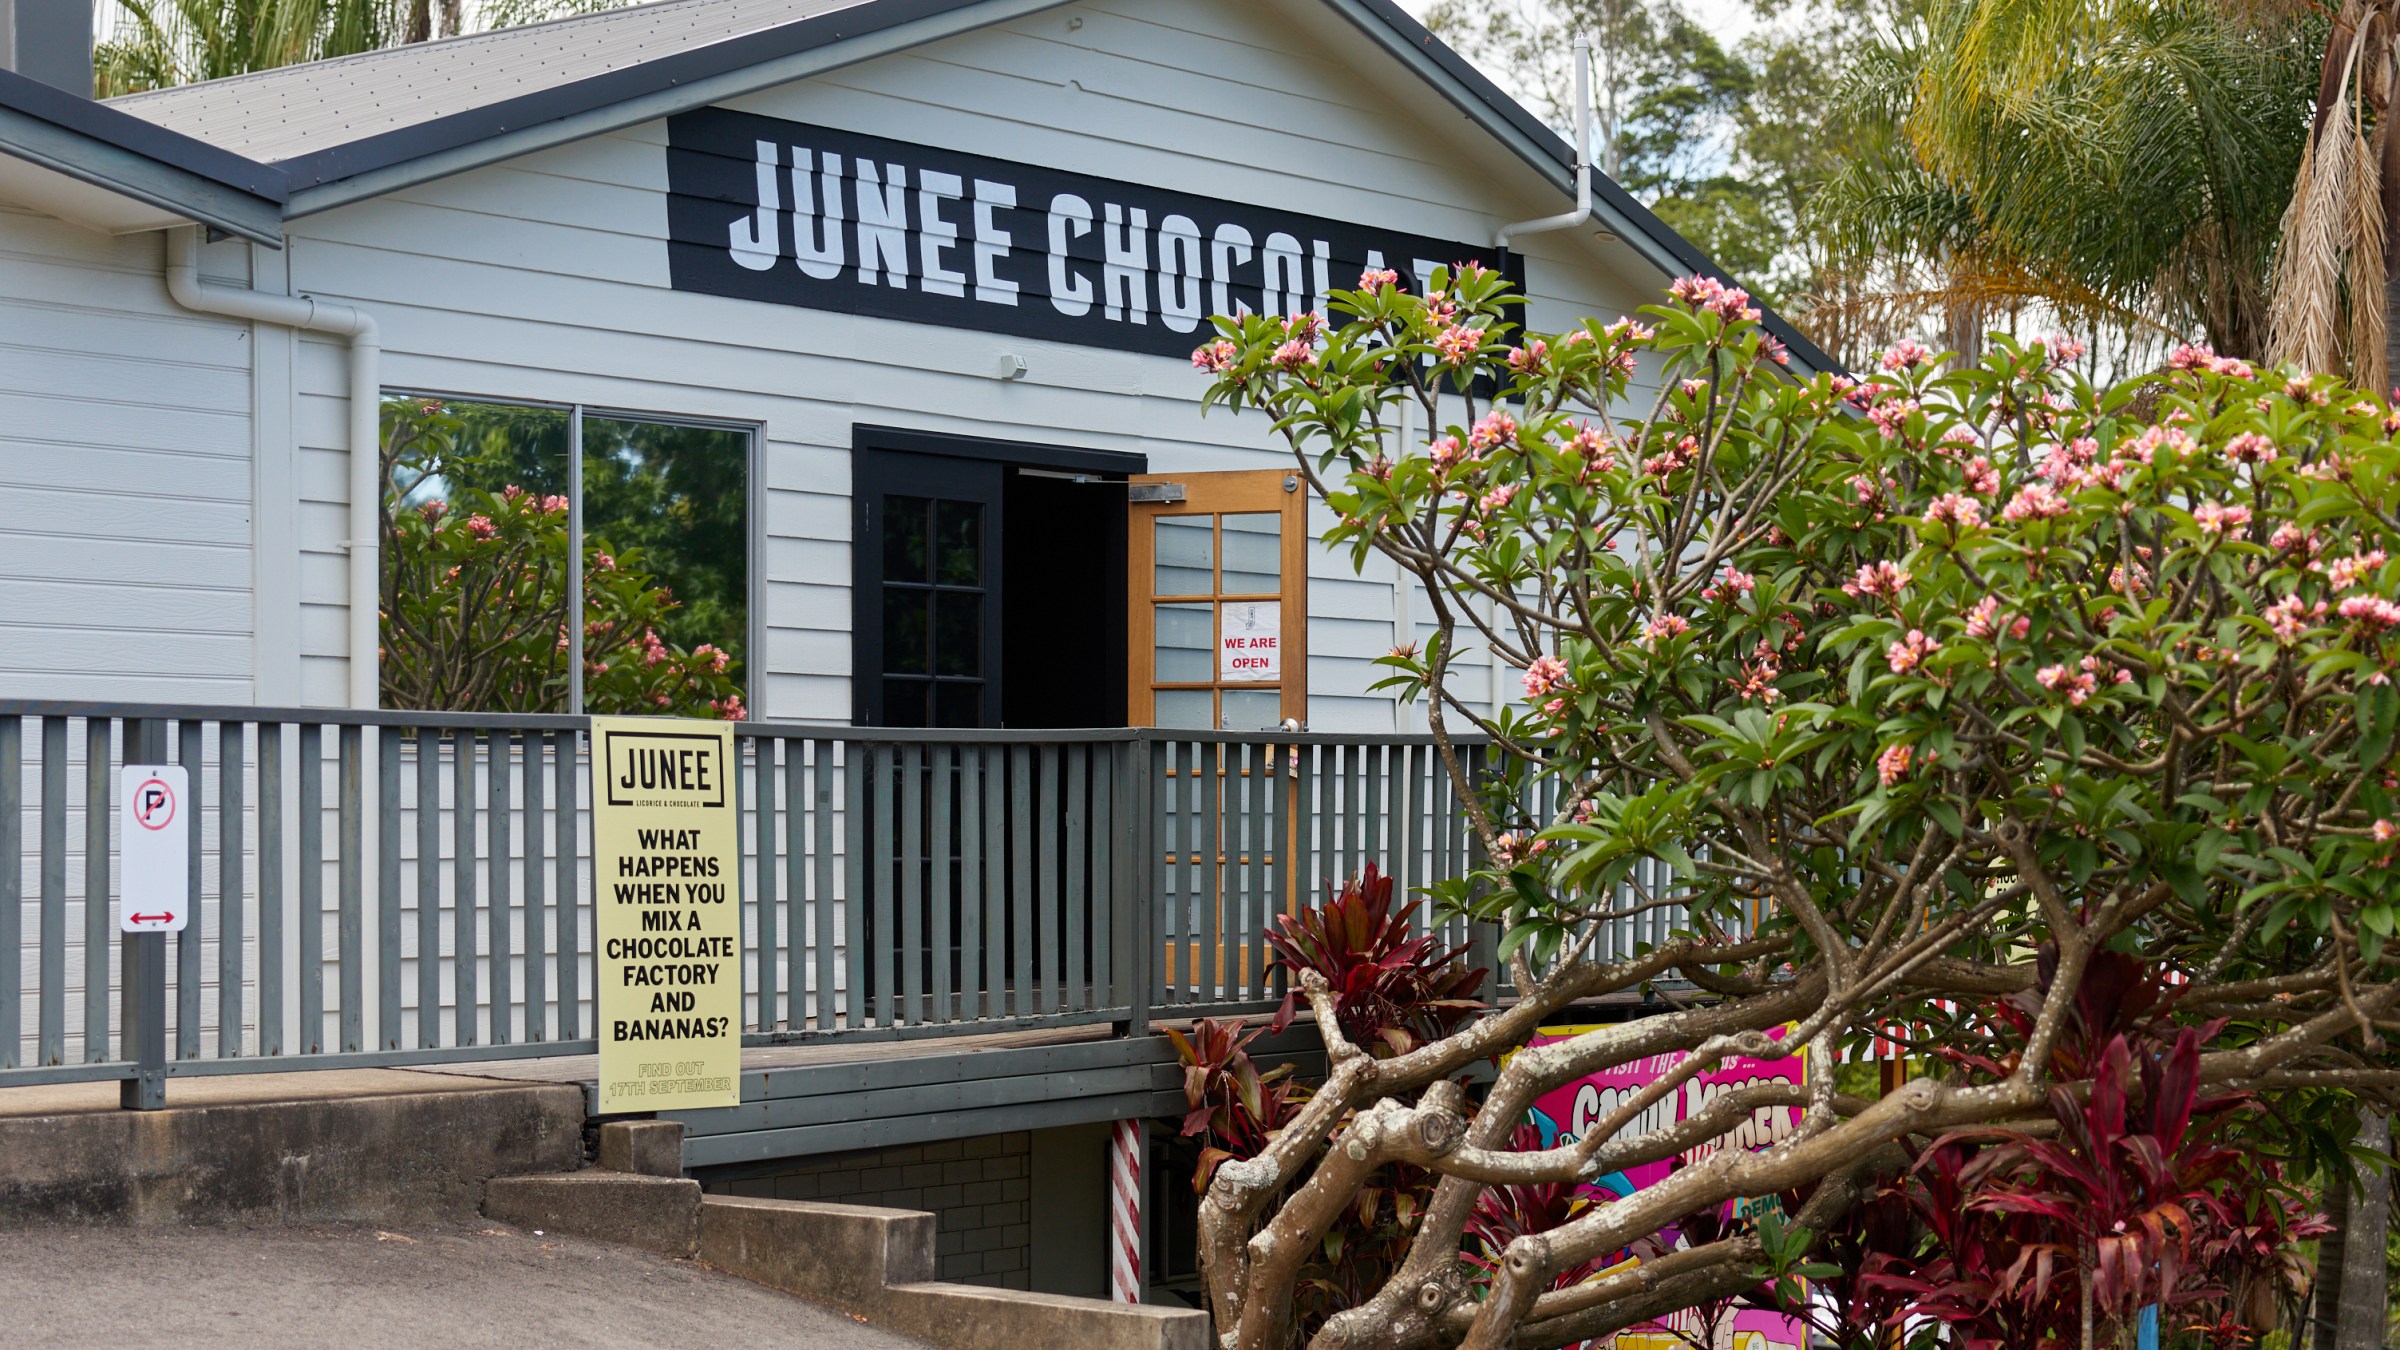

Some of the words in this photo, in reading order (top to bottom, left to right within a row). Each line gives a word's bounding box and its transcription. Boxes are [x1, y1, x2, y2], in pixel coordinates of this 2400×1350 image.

[729, 139, 1019, 308] JUNEE
[1047, 193, 1489, 377] CHOCOLAT
[1225, 638, 1245, 648] WE
[1249, 637, 1277, 648] ARE
[1232, 657, 1269, 668] OPEN
[620, 748, 712, 791] JUNEE
[636, 799, 662, 807] LICORICE
[669, 800, 700, 808] CHOCOLATE
[638, 829, 701, 850] WHAT
[619, 856, 720, 877] HAPPENS
[614, 883, 680, 904] WHEN
[684, 883, 725, 904] YOU
[642, 910, 682, 932] MIX
[687, 910, 702, 931] A
[606, 937, 734, 960] CHOCOLATE
[623, 963, 719, 986] FACTORY
[650, 991, 695, 1013] AND
[614, 1017, 729, 1041] BANANAS?
[638, 1063, 672, 1078] FIND
[675, 1061, 705, 1076] OUT
[1650, 1052, 1679, 1074] THE
[609, 1081, 646, 1097] 17TH
[649, 1077, 732, 1095] SEPTEMBER
